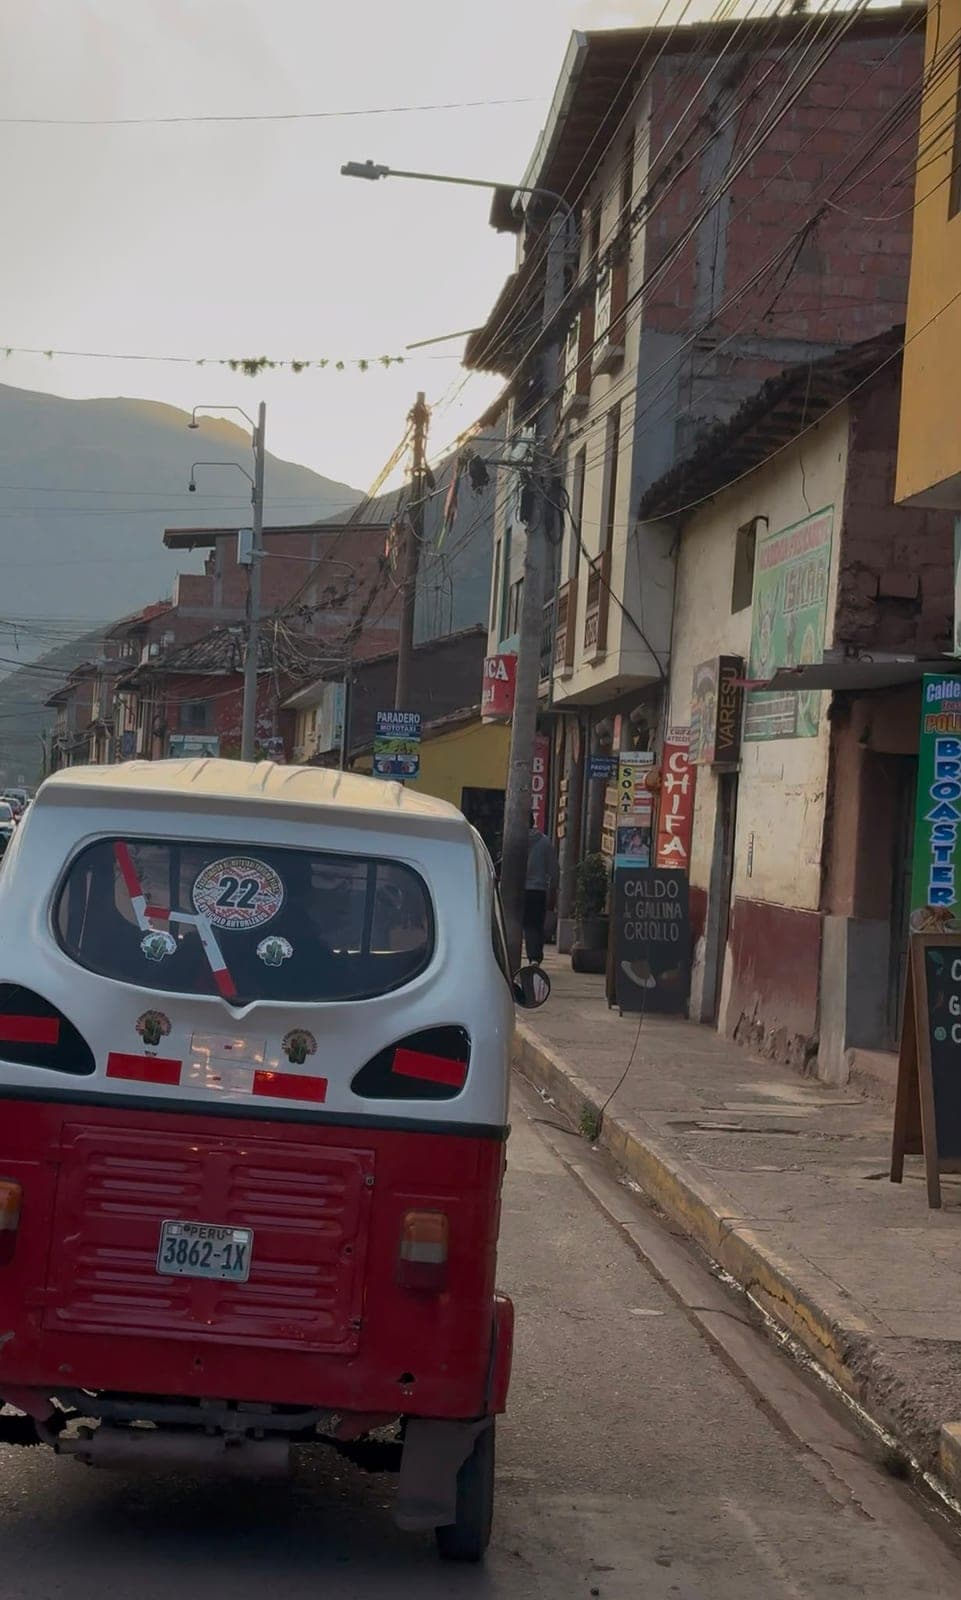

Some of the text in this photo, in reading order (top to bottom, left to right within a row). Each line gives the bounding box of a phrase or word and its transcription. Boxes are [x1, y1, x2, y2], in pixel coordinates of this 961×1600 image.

[376, 711, 421, 724] PARADERO
[621, 767, 633, 812] SOAT
[659, 751, 690, 858] CHIFA
[926, 738, 961, 907] BROASTER
[216, 876, 260, 910] 22
[624, 880, 679, 898] CALDO
[624, 921, 680, 941] CRIOLLO
[190, 1226, 225, 1240] PERU
[163, 1237, 246, 1272] 3862-1X
